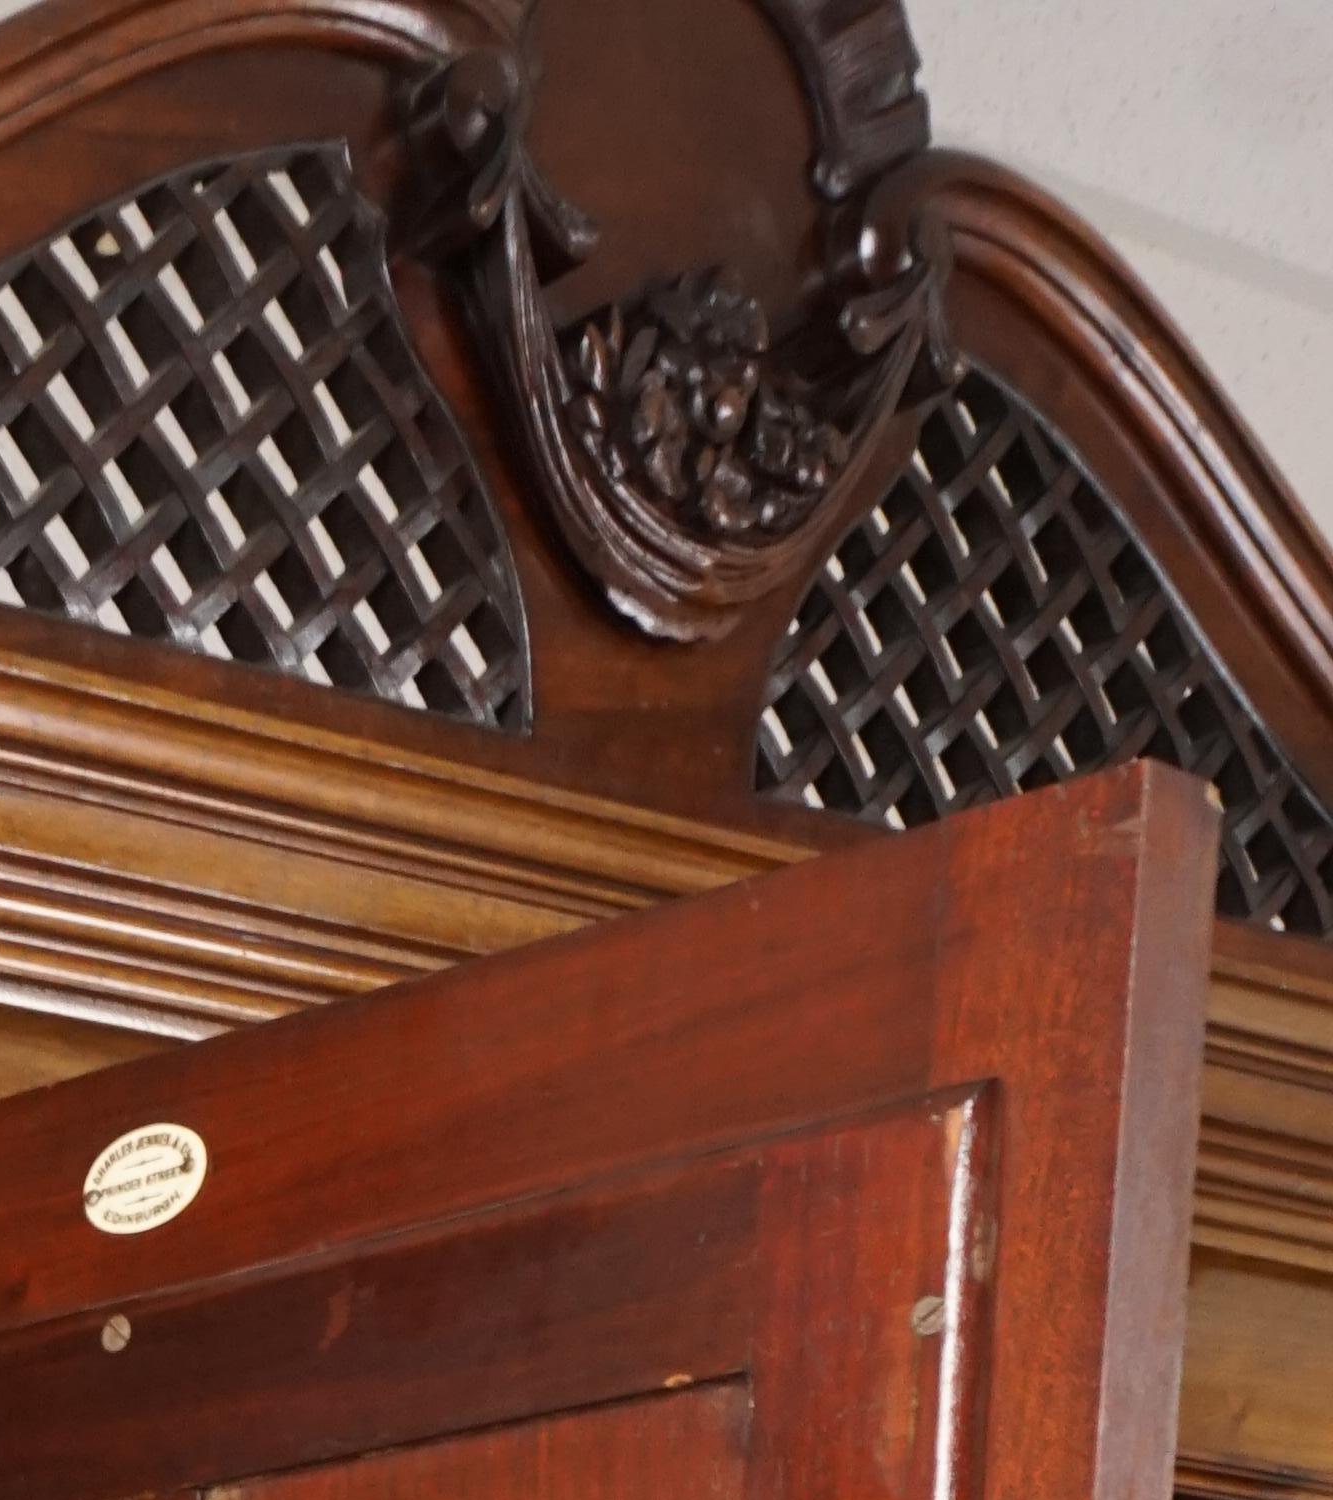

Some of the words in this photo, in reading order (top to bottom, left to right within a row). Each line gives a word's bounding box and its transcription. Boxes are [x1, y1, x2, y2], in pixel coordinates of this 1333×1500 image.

[93, 1140, 133, 1185] CHARLES
[102, 1178, 141, 1196] PRINCES
[145, 1166, 183, 1186] STREET
[103, 1190, 181, 1224] EDINBURGH
